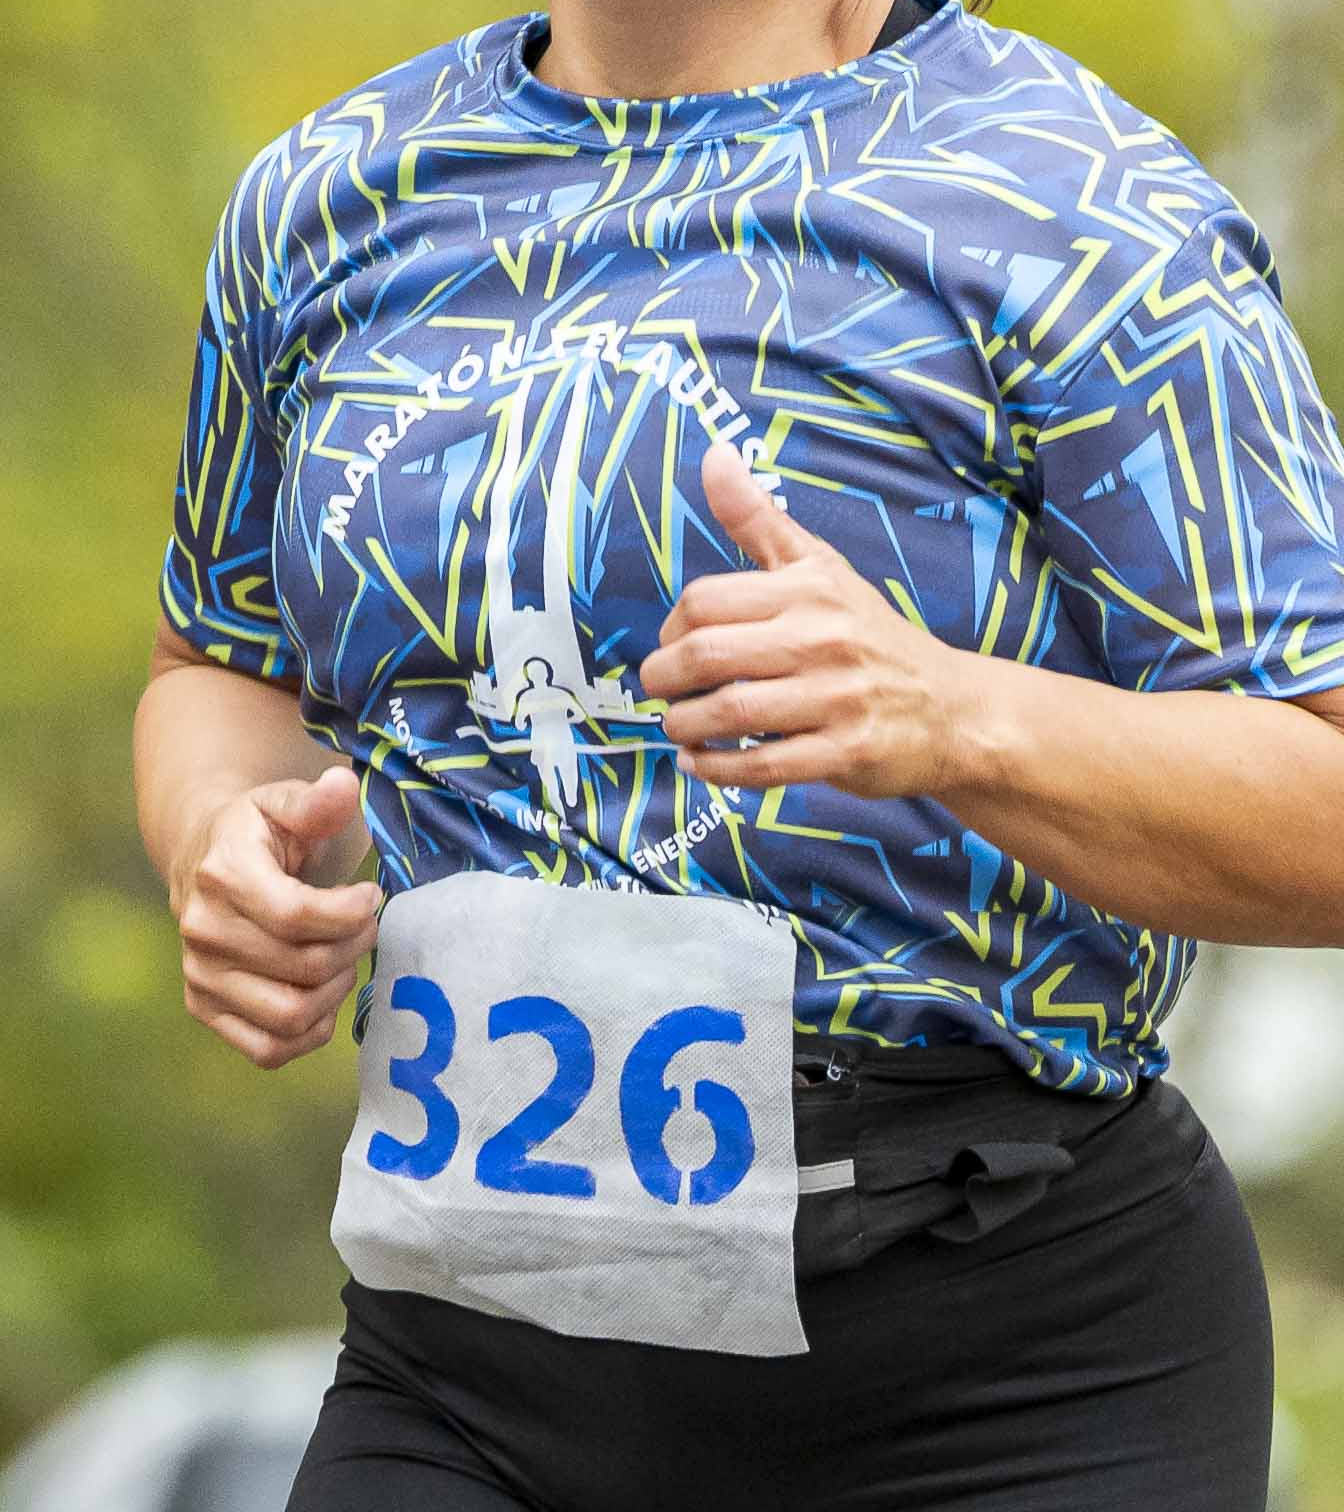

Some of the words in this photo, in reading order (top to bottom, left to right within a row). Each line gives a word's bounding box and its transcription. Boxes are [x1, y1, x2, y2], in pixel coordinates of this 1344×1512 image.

[322, 334, 527, 543] MARATÓN
[578, 325, 628, 368] EL
[630, 805, 731, 875] ENERGÍA
[366, 975, 756, 1207] 326
